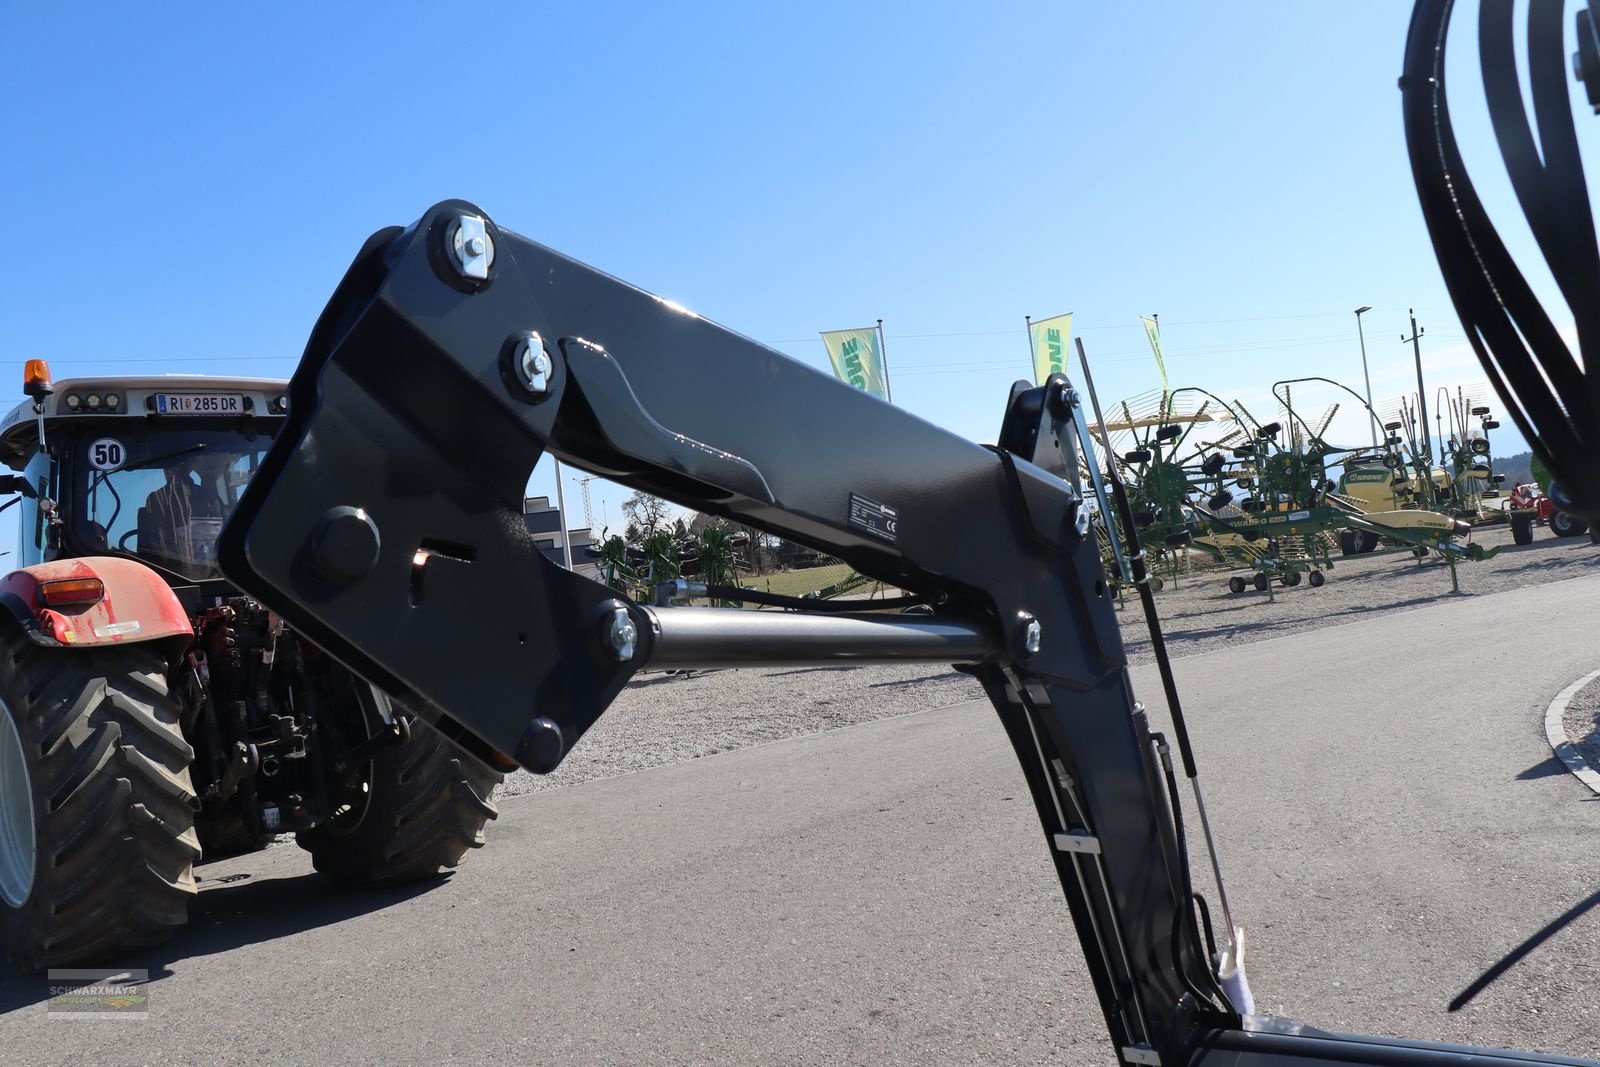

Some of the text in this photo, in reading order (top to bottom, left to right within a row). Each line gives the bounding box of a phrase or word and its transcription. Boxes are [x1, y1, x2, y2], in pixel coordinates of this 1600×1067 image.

[170, 397, 237, 410] RI 285 DR
[95, 444, 120, 465] 50
